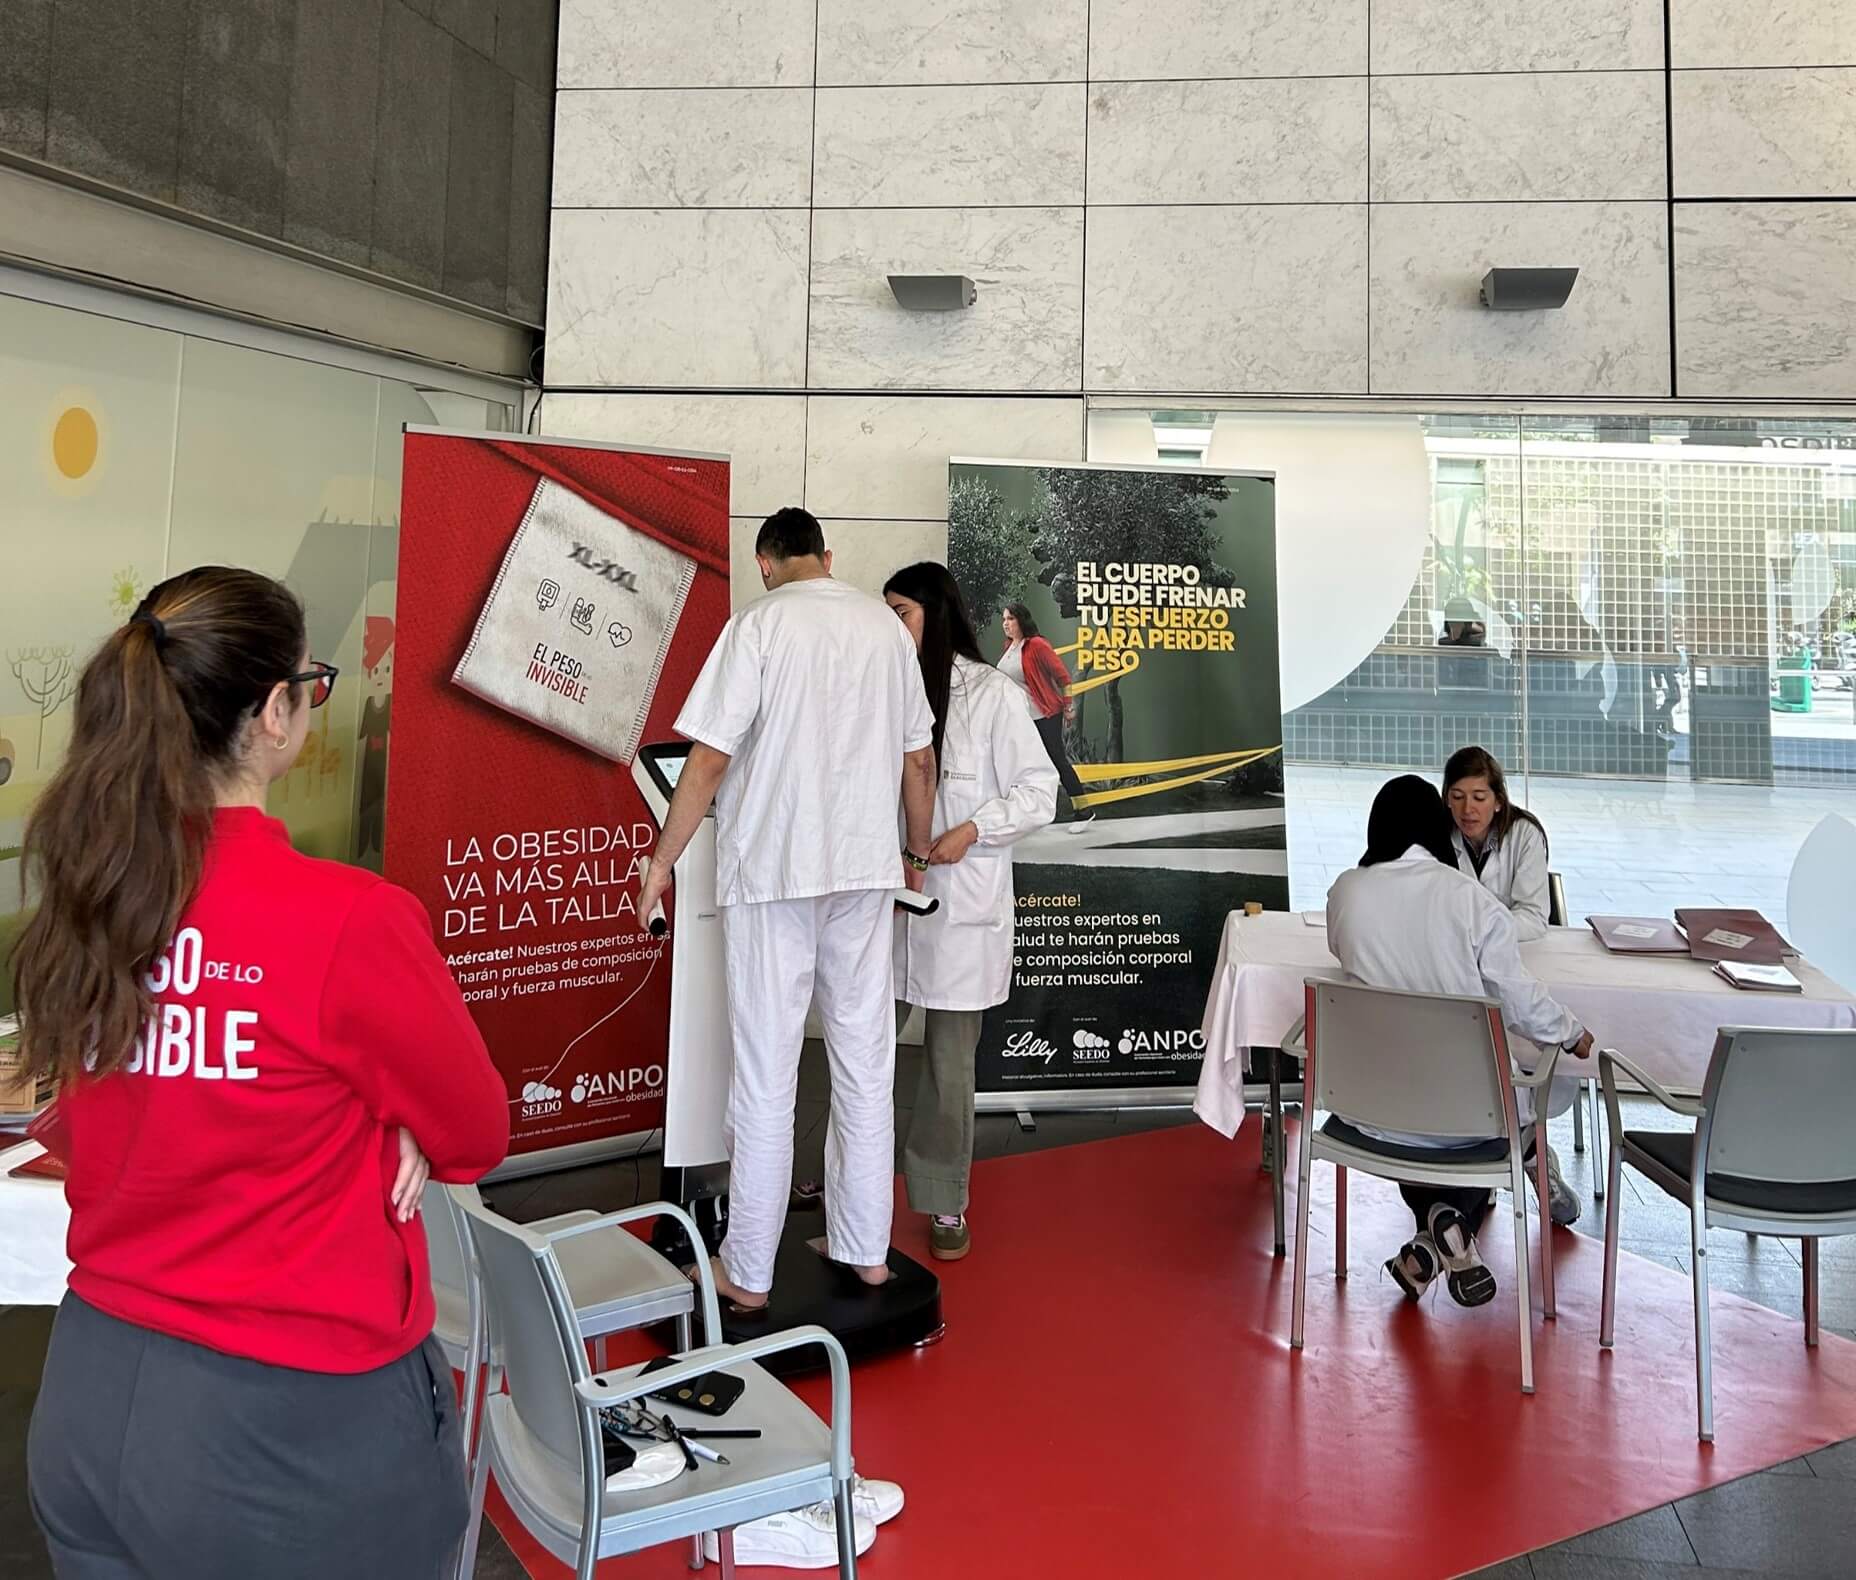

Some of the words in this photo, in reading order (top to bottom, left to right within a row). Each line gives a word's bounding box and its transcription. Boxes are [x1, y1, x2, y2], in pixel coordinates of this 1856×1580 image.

[567, 541, 639, 594] XL-XXL
[1077, 562, 1102, 582] EL
[1105, 562, 1200, 585] CUERPO
[1077, 583, 1152, 605] PUEDE
[1156, 586, 1246, 608] FRENAR
[1077, 605, 1108, 626] TU
[1113, 606, 1229, 629] ESFUERZO
[1078, 627, 1144, 649] PARA
[1149, 629, 1234, 650] PERDER
[533, 642, 548, 664] EL
[550, 650, 583, 679] PESO
[1078, 649, 1140, 671] PESO
[526, 660, 589, 705] INVISIBLE
[447, 837, 484, 866] LA
[492, 823, 653, 861] OBESIDAD
[443, 871, 485, 901] VA
[496, 860, 564, 896] MÁS
[572, 851, 641, 888] ALLÁ
[1014, 893, 1081, 907] cércate!
[444, 905, 487, 937] DE
[499, 901, 538, 930] LA
[545, 891, 636, 925] TALLA
[1014, 913, 1070, 927] uestros
[1074, 913, 1138, 929] expertos
[1142, 914, 1161, 925] en
[443, 946, 513, 966] Acércate!
[517, 940, 577, 958] Nuestros
[581, 933, 634, 952] expertos
[1013, 933, 1045, 947] alud
[1050, 934, 1064, 946] te
[1068, 931, 1113, 946] harán
[1118, 931, 1180, 949] pruebas
[458, 968, 498, 984] harán
[502, 959, 558, 981] pruebas
[562, 956, 578, 969] de
[582, 946, 662, 969] composición
[1013, 956, 1023, 967] e
[1026, 950, 1125, 970] composición
[1129, 949, 1192, 968] corporal
[205, 961, 231, 980] DE
[234, 963, 263, 984] LO
[1016, 972, 1063, 987] fuerza
[1067, 971, 1143, 985] muscular.
[463, 985, 497, 1002] poral
[500, 986, 510, 1000] y
[513, 978, 555, 996] fuerza
[559, 970, 623, 990] muscular.
[1002, 1031, 1058, 1064] Lilly
[1133, 1029, 1207, 1051] ANPO
[1072, 1049, 1110, 1060] SEEDO
[1171, 1051, 1206, 1060] obesida
[587, 1064, 664, 1098] ANPO
[625, 1087, 664, 1102] obesidad
[521, 1100, 562, 1118] SEEDO
